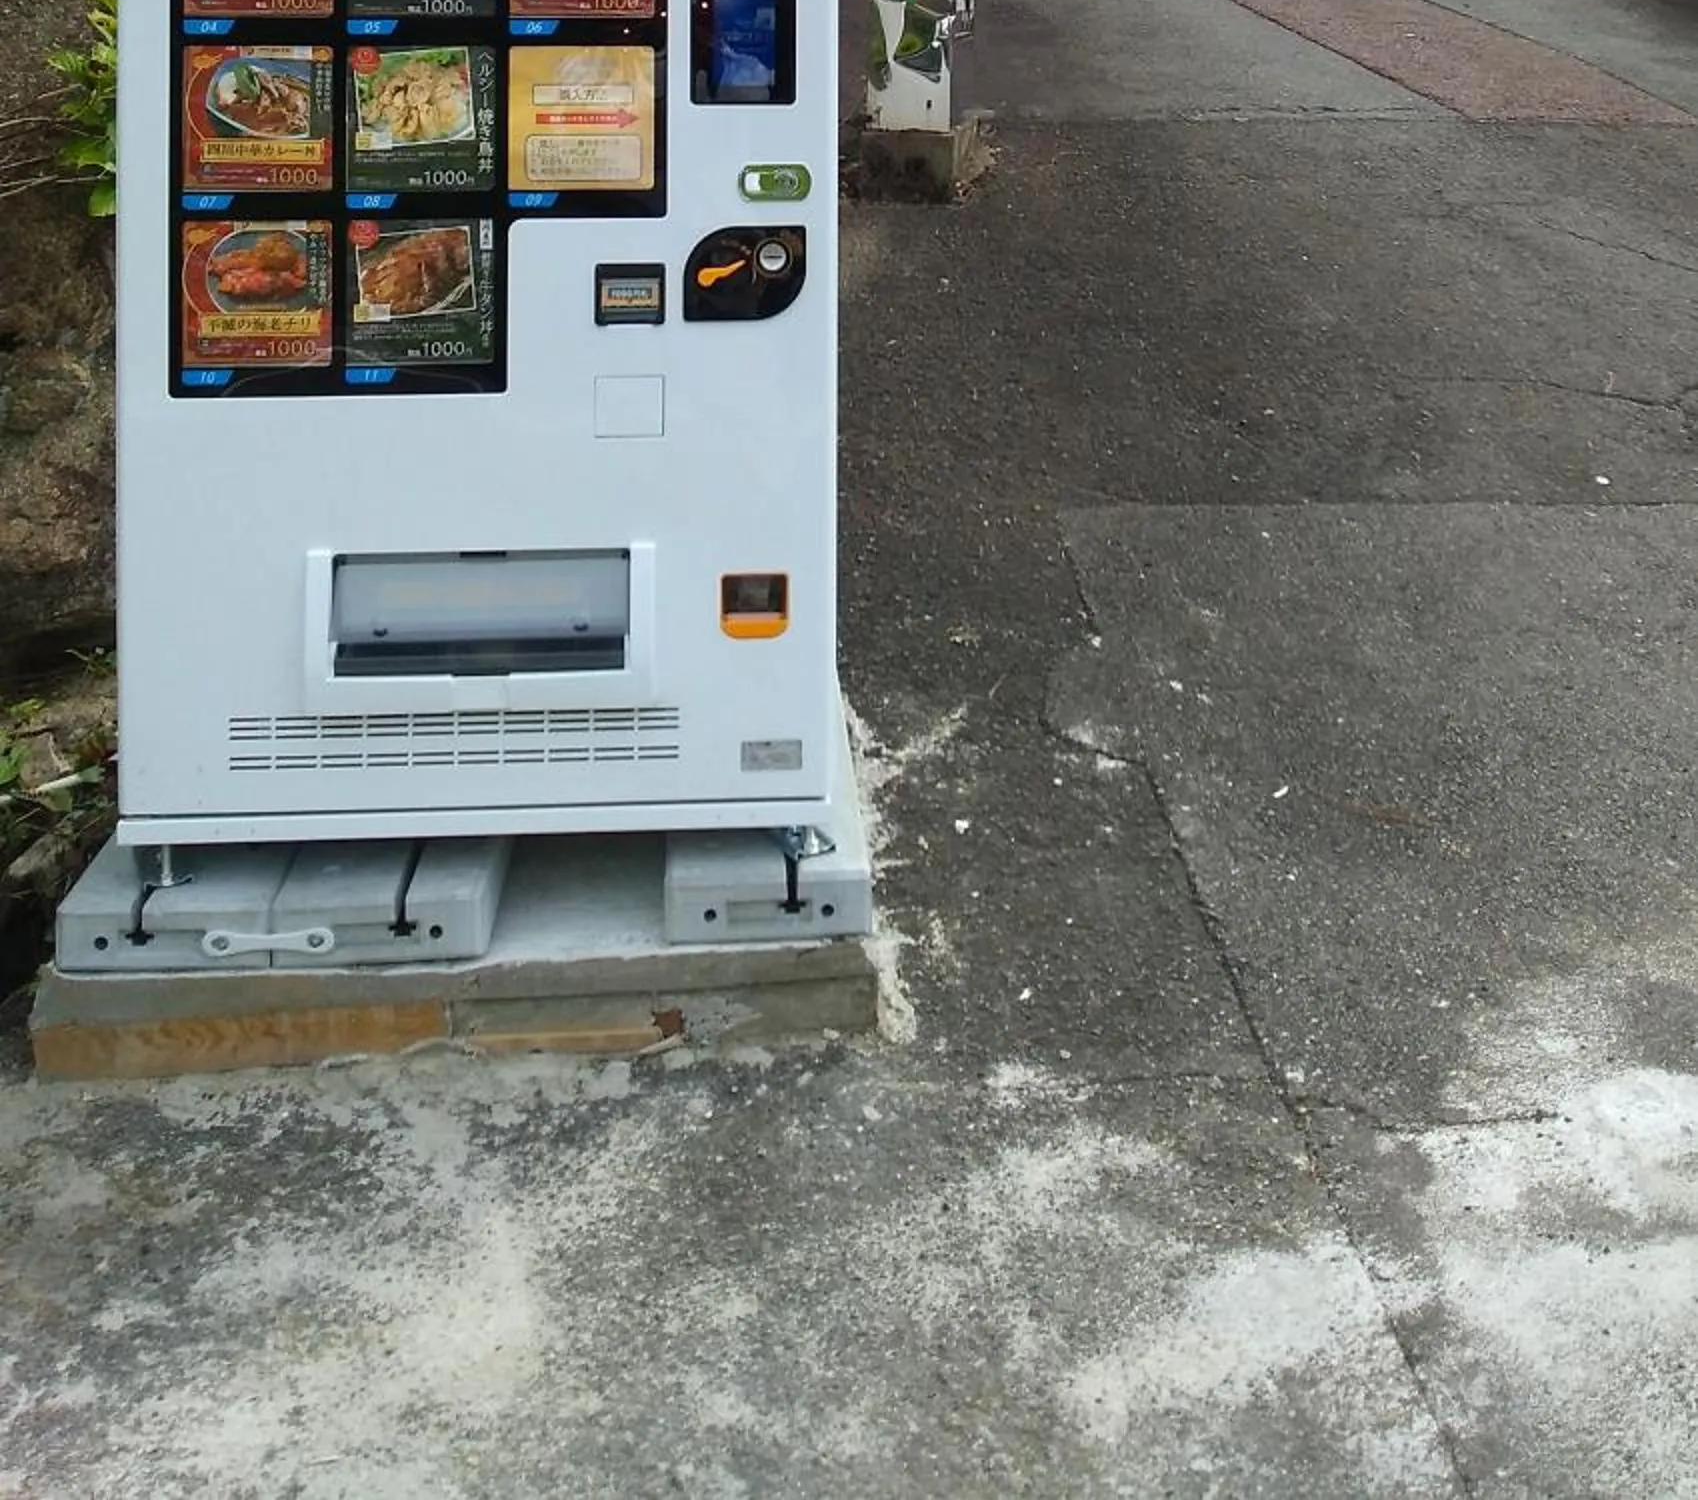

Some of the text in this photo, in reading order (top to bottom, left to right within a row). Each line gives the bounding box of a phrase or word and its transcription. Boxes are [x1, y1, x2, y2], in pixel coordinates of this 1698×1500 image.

[201, 21, 218, 33] 04
[364, 21, 382, 33] 05
[527, 21, 543, 33] 06
[476, 52, 495, 175] ヘルシー焼き鳥丼
[199, 196, 217, 208] 07
[363, 195, 382, 208] 08
[525, 194, 543, 207] 09
[200, 371, 215, 383] 10
[365, 369, 379, 381] 11
